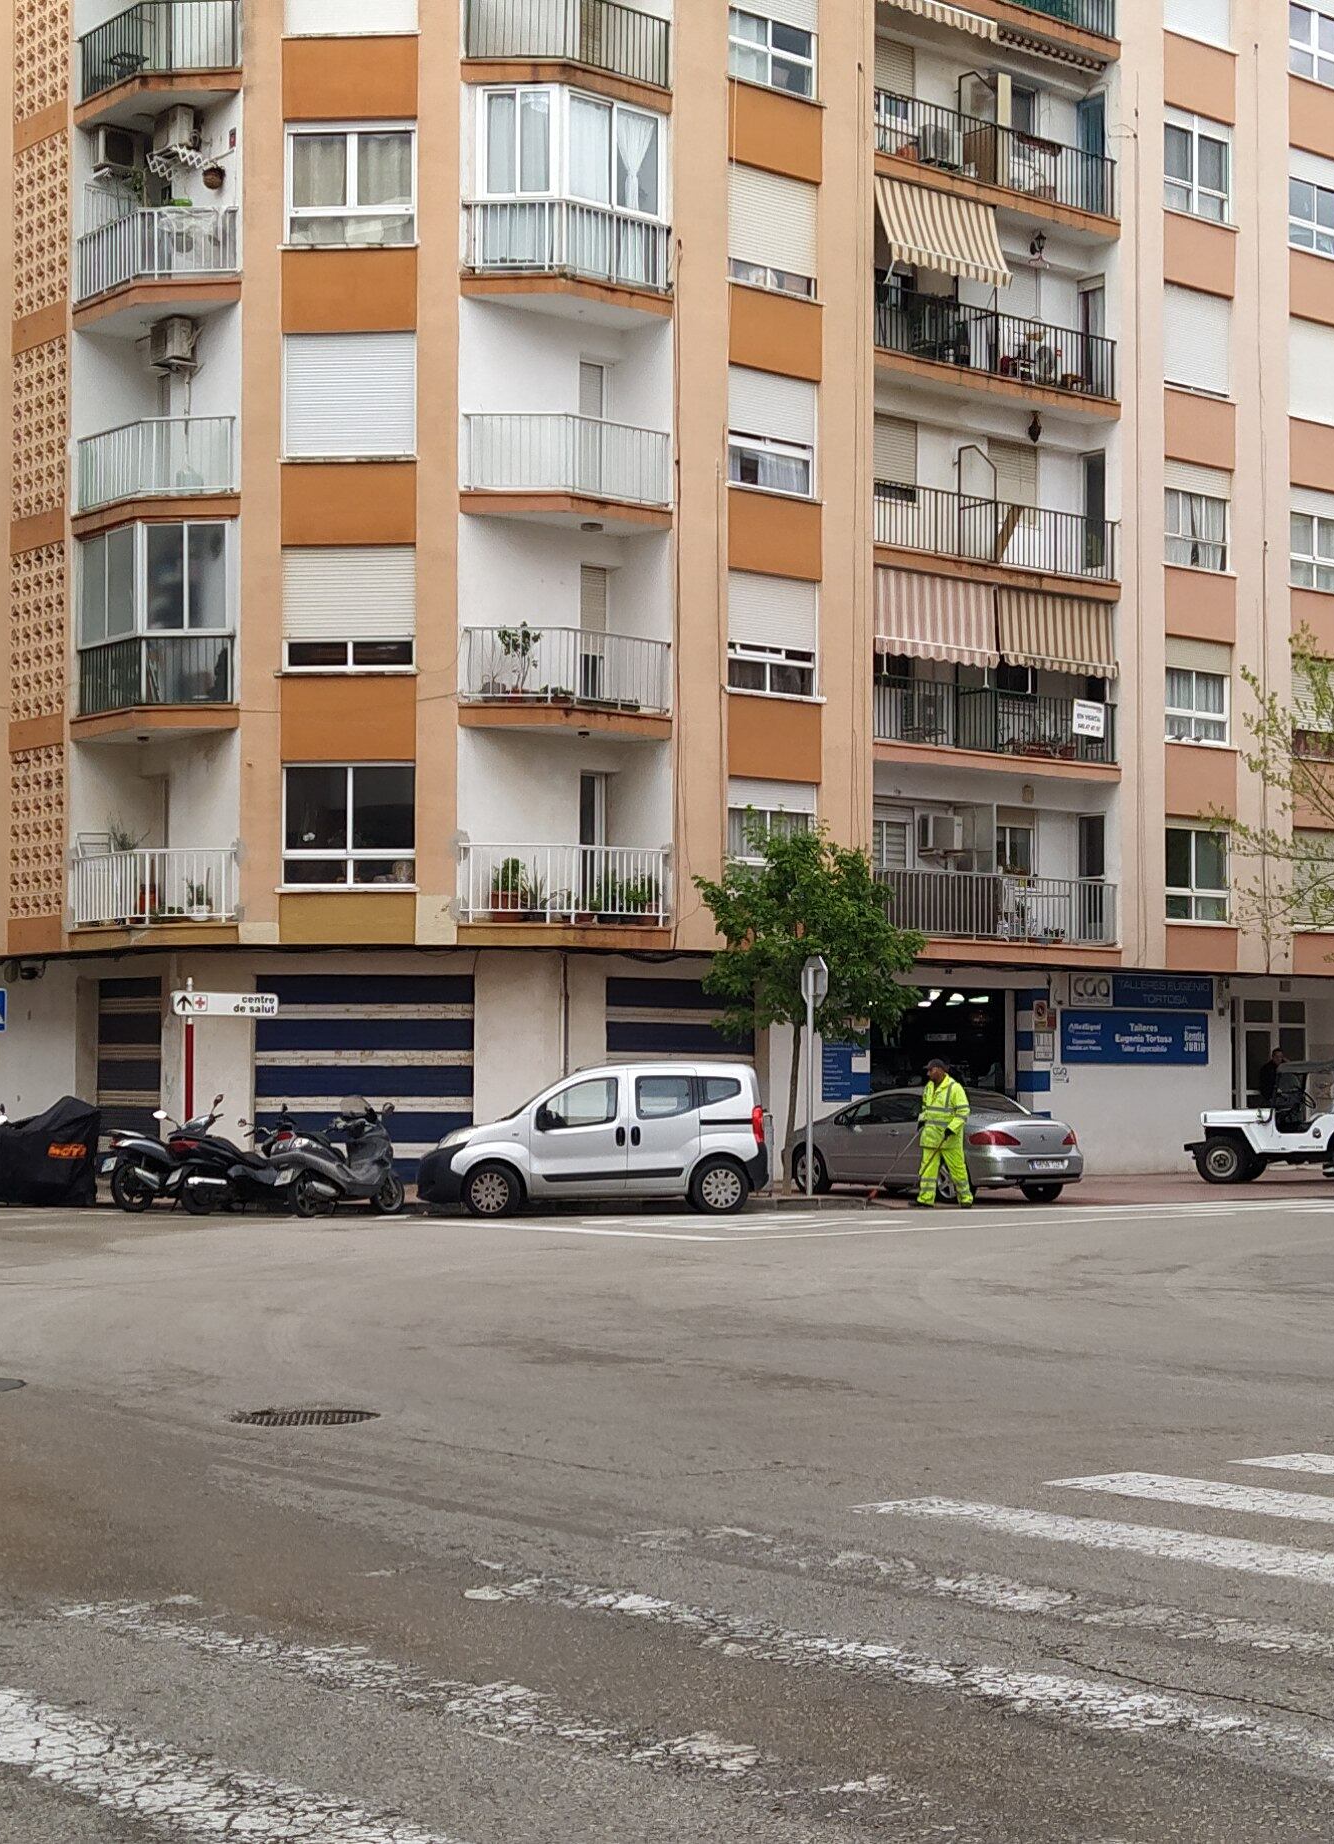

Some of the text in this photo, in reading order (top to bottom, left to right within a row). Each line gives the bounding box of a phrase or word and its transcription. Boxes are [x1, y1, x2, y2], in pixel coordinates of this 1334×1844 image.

[1118, 979, 1210, 992] TALLERES EUGENIO
[242, 996, 275, 1004] centre
[1143, 993, 1189, 1004] TORTOSA
[233, 1004, 275, 1014] de salut
[1129, 1023, 1158, 1032] Talleres
[1115, 1034, 1172, 1044] Eugenio Tortosa
